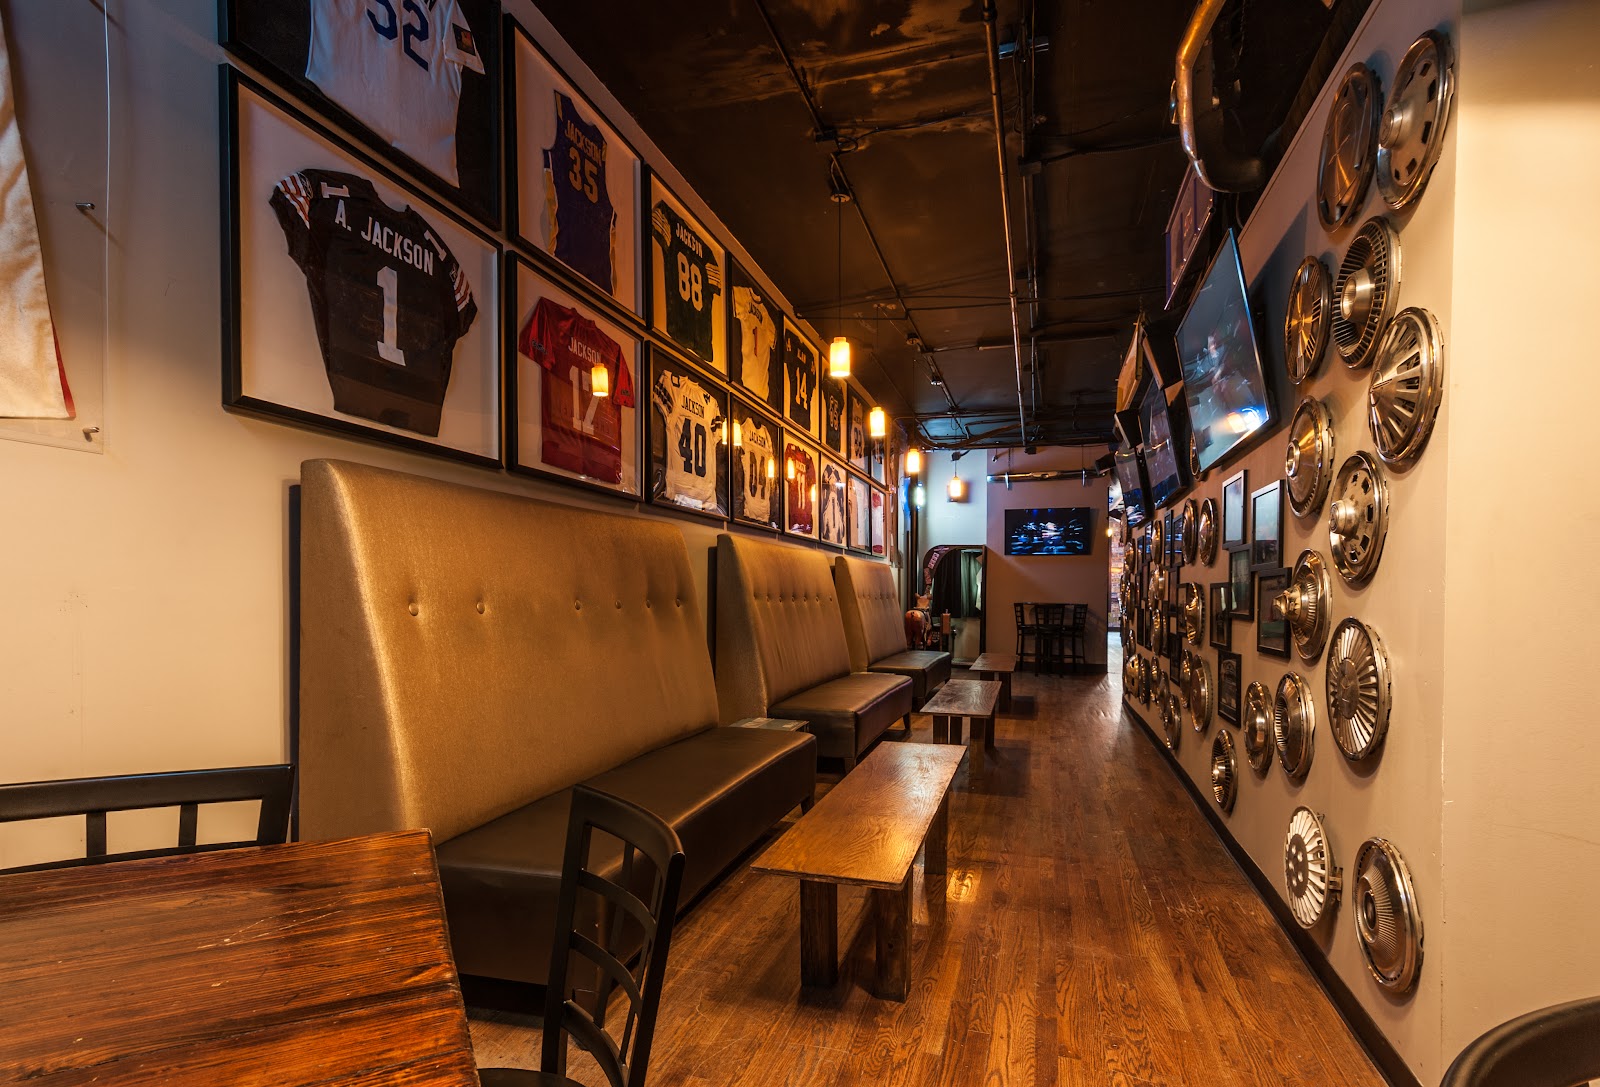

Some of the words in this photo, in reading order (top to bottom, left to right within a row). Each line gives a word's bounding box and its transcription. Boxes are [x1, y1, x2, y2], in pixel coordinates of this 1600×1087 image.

[564, 119, 601, 167] JACKSON
[569, 146, 598, 204] 35
[334, 199, 352, 232] A.
[360, 216, 434, 277] JACKSON
[675, 222, 703, 259] JACKSON
[677, 251, 703, 312] 88
[376, 265, 406, 367] 1
[752, 326, 759, 357] 1
[568, 336, 602, 364] JACKSON
[569, 365, 600, 436] 17
[681, 394, 705, 419] JACKSON
[796, 366, 808, 411] 14
[678, 418, 706, 478] 40
